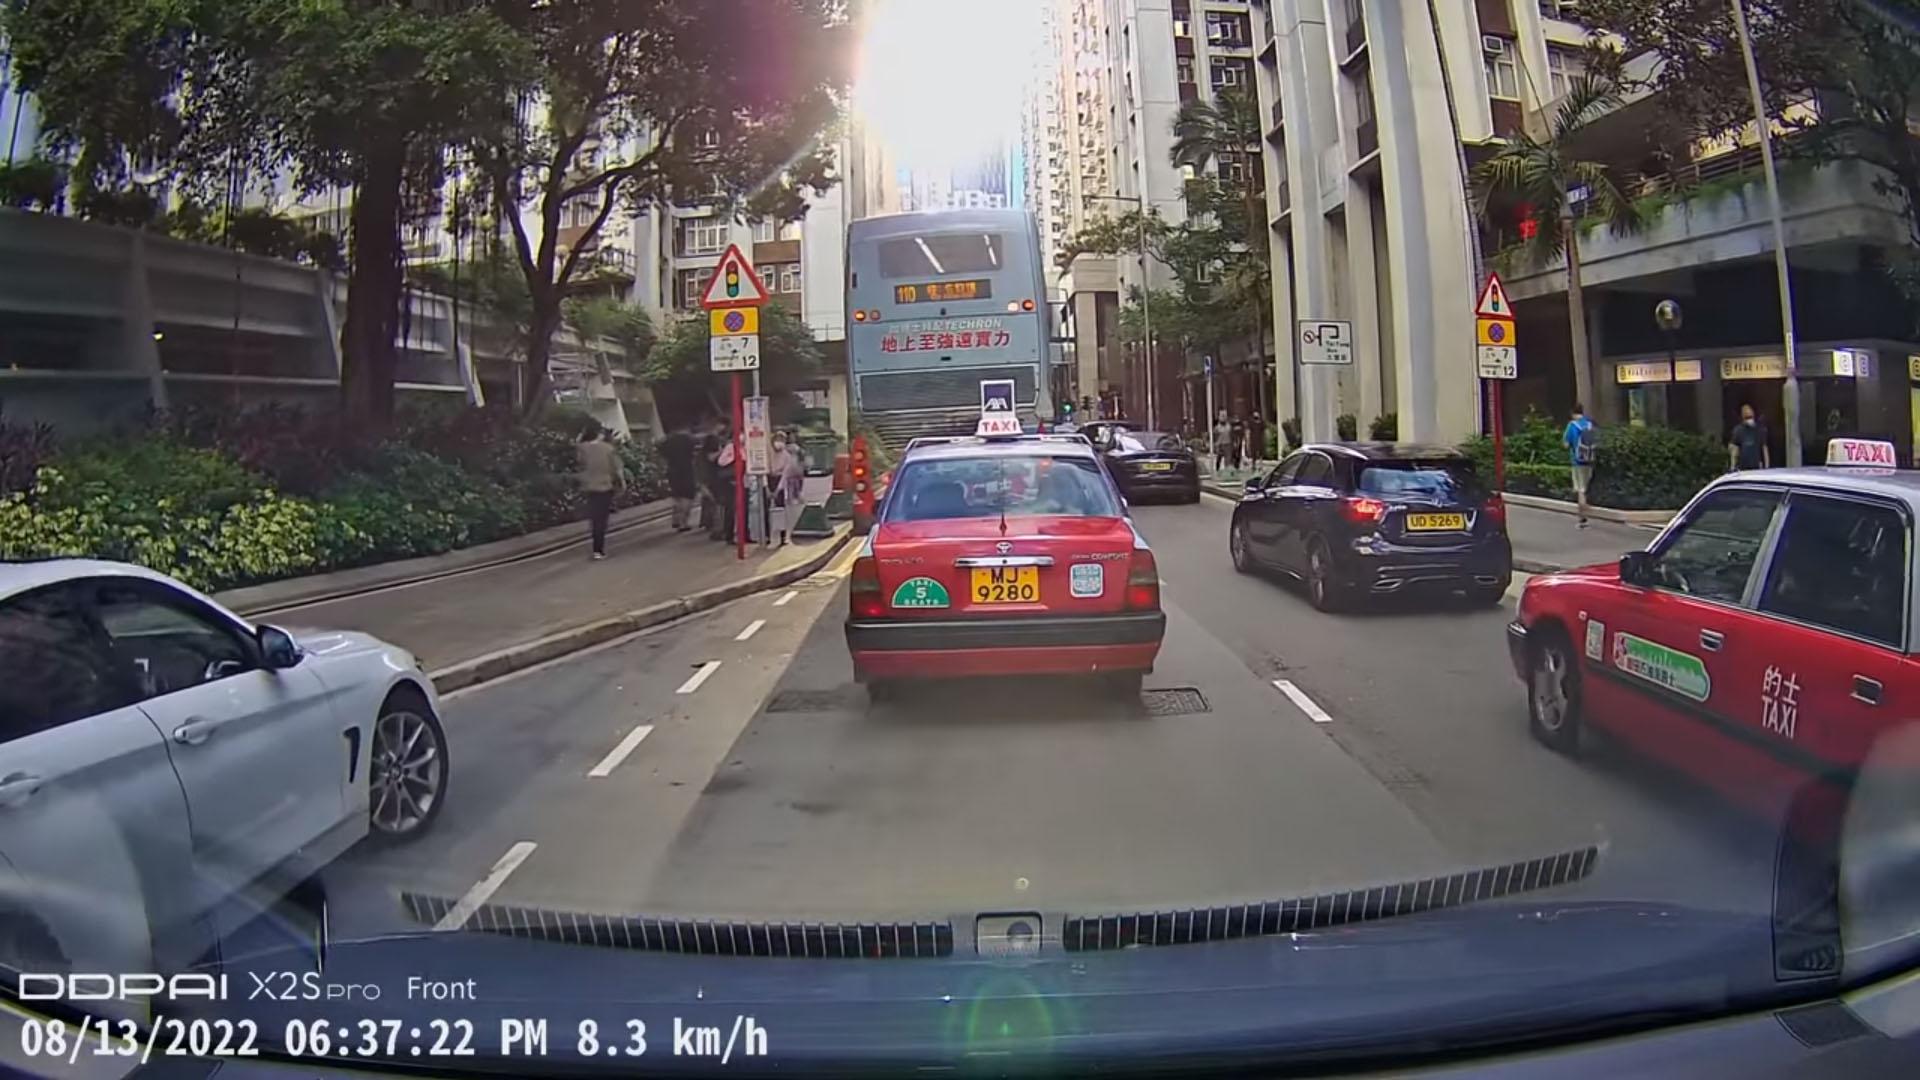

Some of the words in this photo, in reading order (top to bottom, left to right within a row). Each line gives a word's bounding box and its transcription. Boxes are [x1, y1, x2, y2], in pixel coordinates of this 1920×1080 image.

[945, 318, 1002, 330] TECHRON
[741, 337, 750, 349] 7
[1502, 348, 1509, 359] 7
[742, 355, 757, 367] 12
[1503, 365, 1514, 376] 12
[981, 421, 1017, 432] TAXI
[1843, 442, 1893, 463] TAXI
[1410, 515, 1427, 527] UD
[1429, 515, 1460, 527] 5269
[991, 566, 1018, 585] MJ
[916, 587, 927, 599] 5
[977, 584, 1033, 602] 9280
[1763, 664, 1801, 706] 的士
[1761, 695, 1797, 739] TAXI
